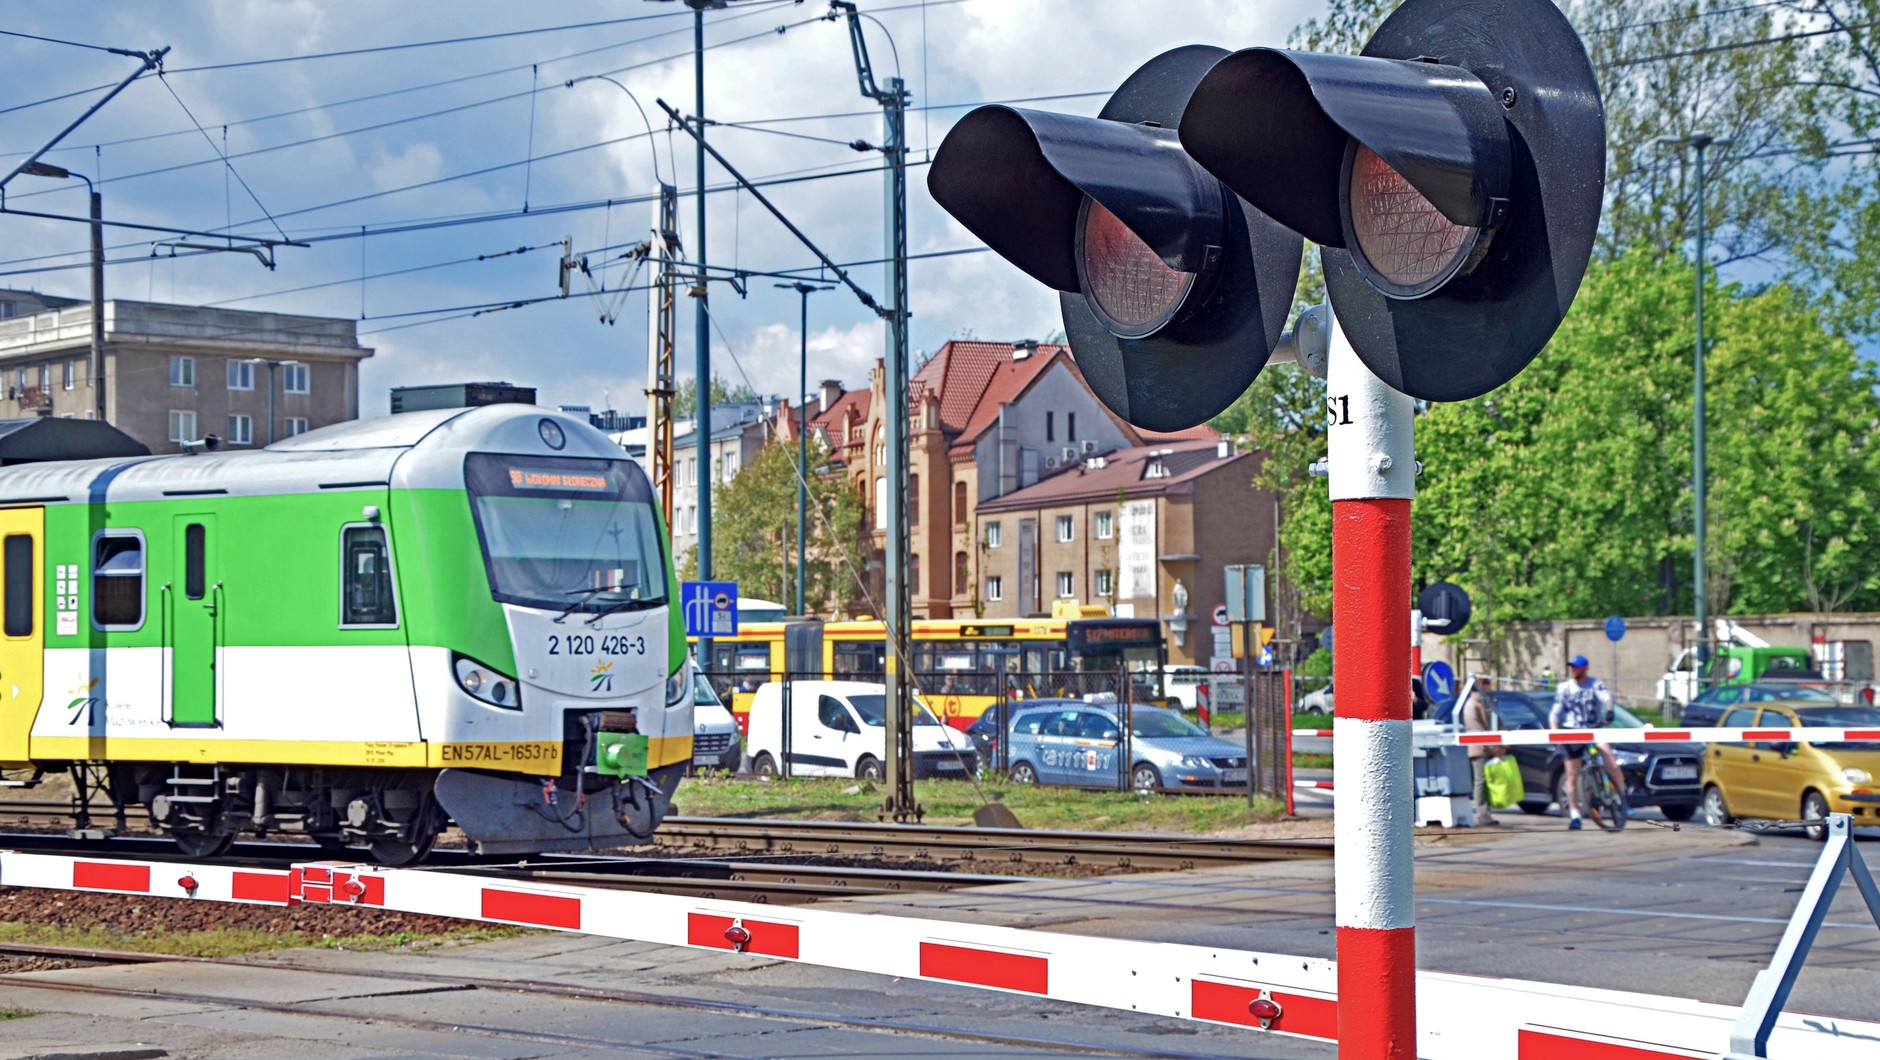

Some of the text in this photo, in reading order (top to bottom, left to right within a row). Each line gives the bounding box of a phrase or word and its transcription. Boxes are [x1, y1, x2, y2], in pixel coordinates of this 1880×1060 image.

[1327, 394, 1354, 426] S1
[548, 635, 645, 656] 2 120 426-3
